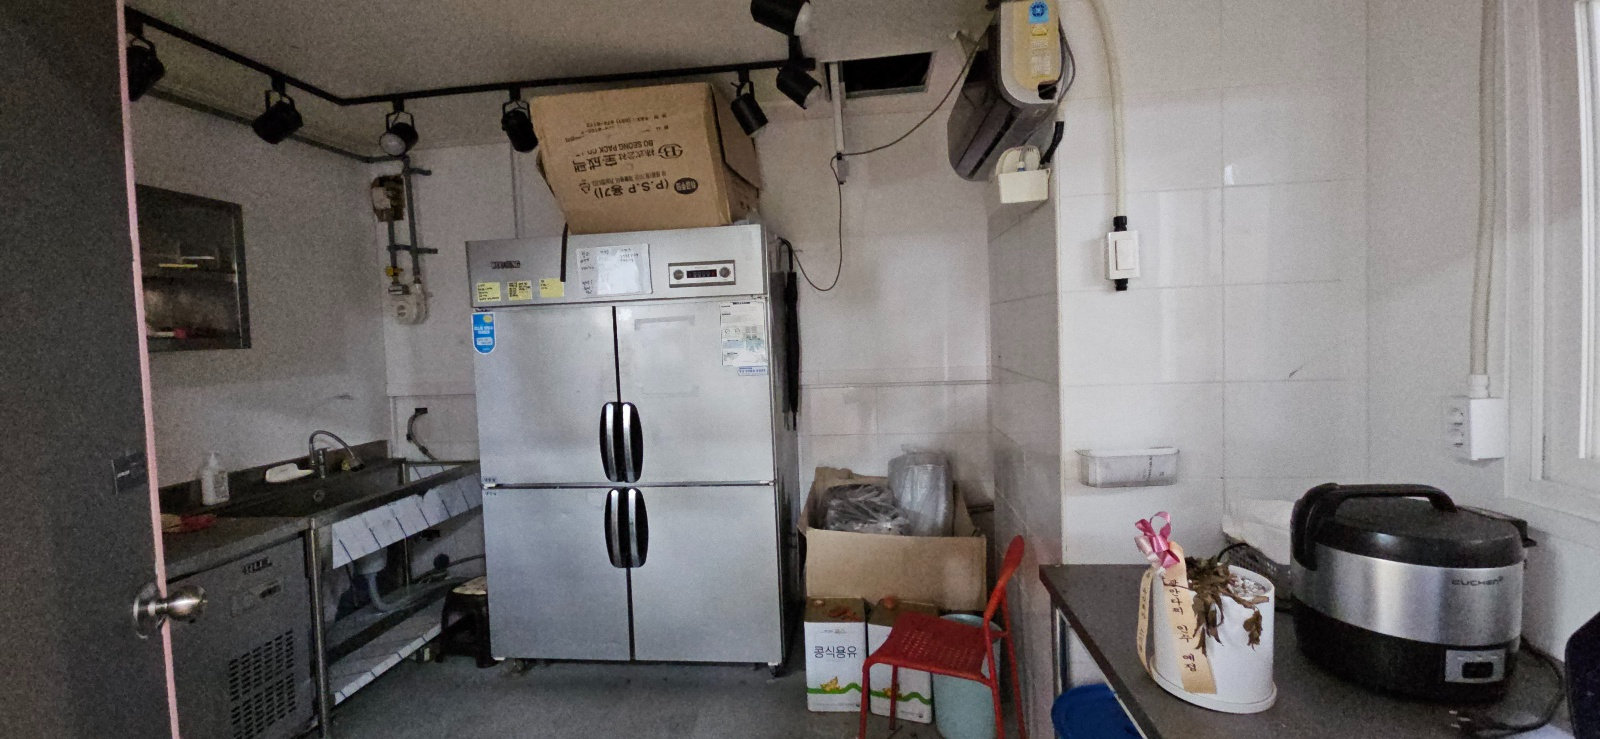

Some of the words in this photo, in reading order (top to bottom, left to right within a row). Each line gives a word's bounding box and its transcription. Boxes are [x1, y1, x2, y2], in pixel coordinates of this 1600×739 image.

[599, 143, 618, 154] PACK
[618, 140, 643, 150] SEONG
[643, 139, 654, 147] BO
[594, 184, 624, 199] 용기)
[813, 645, 858, 659] 콩식용유
